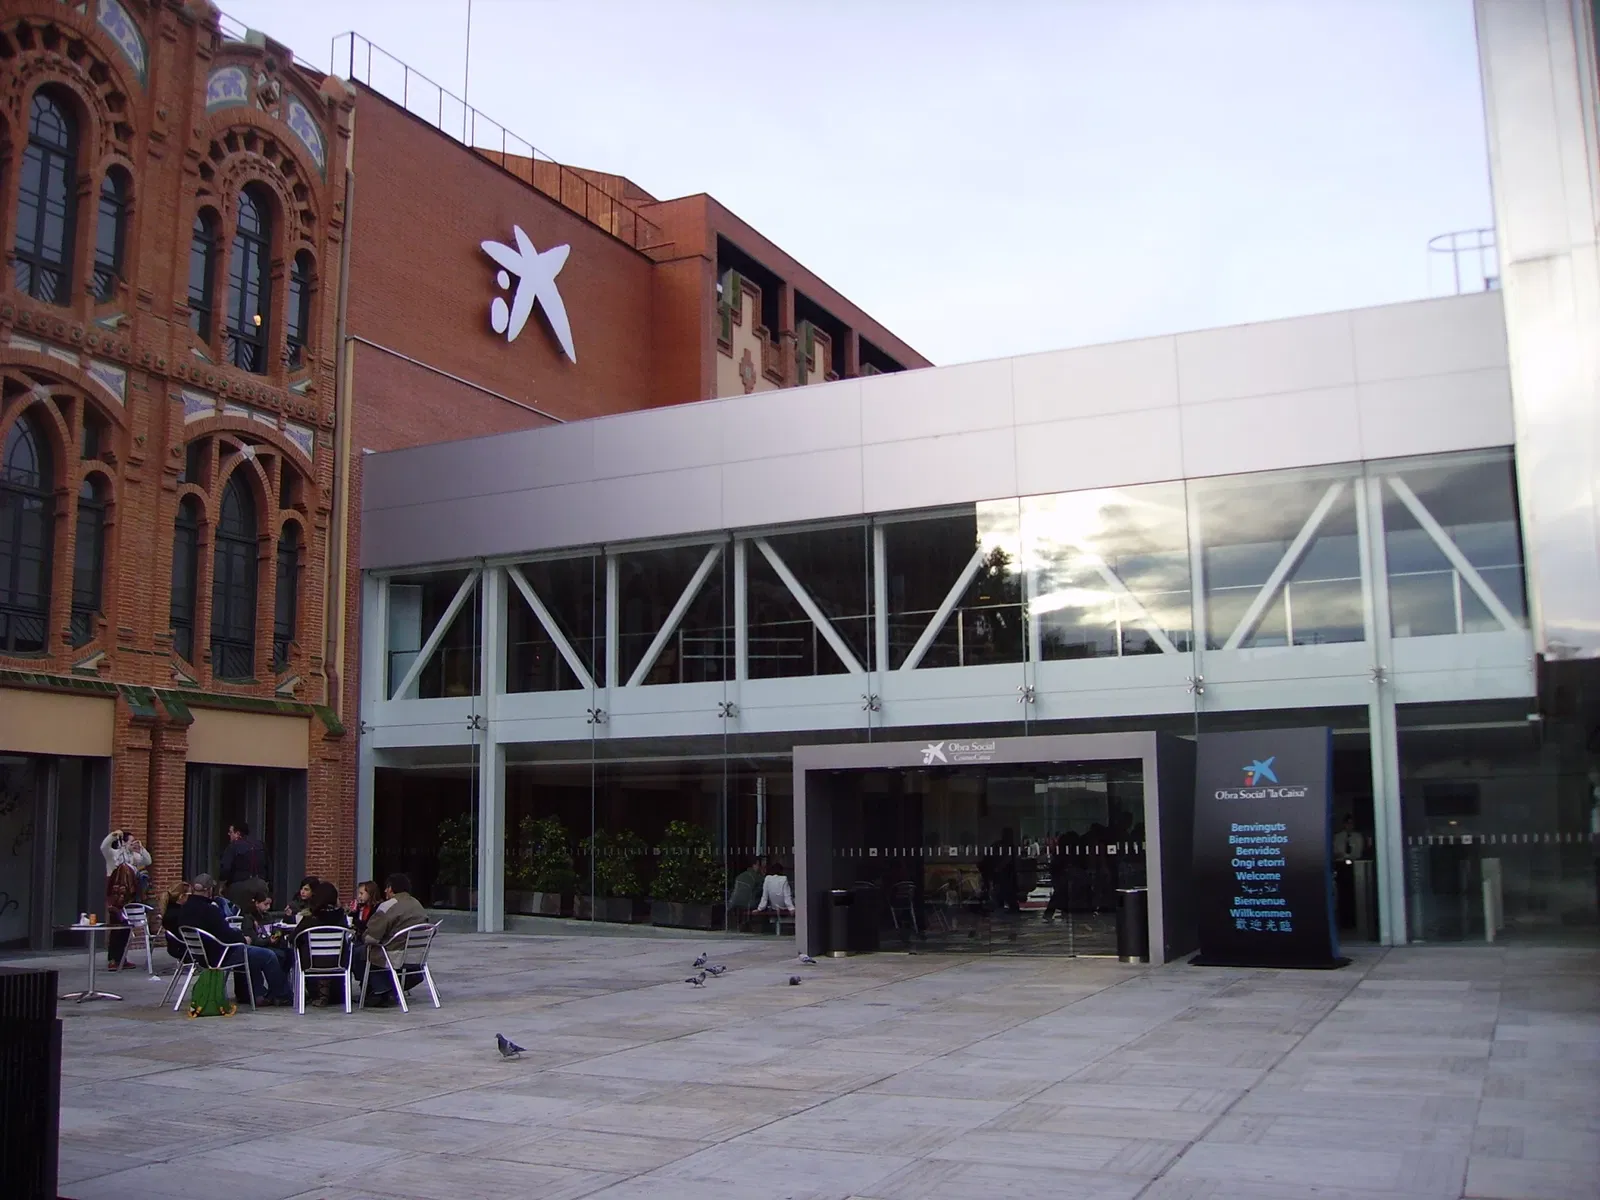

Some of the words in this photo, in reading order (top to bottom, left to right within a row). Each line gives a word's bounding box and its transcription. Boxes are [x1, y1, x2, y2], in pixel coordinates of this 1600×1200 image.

[948, 742, 970, 751] Obra
[971, 741, 996, 751] Social
[1215, 790, 1238, 800] Obra
[1239, 789, 1266, 799] Social
[1231, 822, 1287, 833] Benvinguts
[1228, 834, 1288, 844] Bienvenidos
[1235, 846, 1281, 856] Benvidos
[1231, 858, 1255, 869] Ongi
[1257, 857, 1285, 867] etorri
[1235, 871, 1281, 881] Welcome
[1234, 896, 1286, 906] Bienvenue
[1229, 908, 1292, 918] Willkommen
